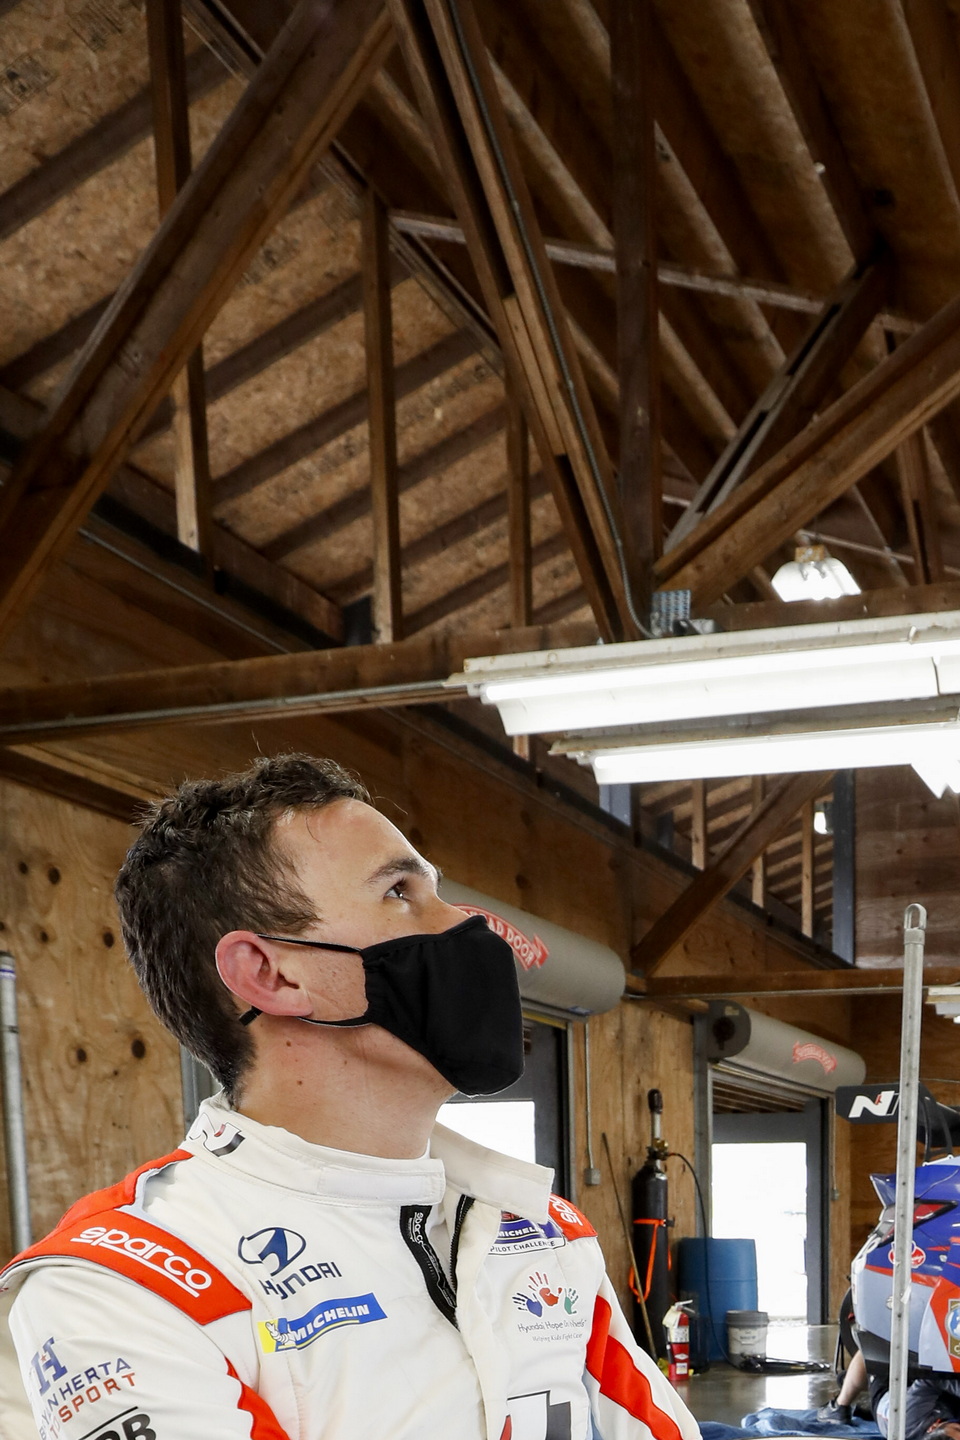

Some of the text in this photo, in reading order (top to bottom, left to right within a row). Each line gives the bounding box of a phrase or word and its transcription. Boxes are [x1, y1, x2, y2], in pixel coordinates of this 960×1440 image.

[507, 928, 535, 965] DOOR
[71, 1226, 212, 1297] sparco
[514, 1240, 555, 1250] CHALLENE
[258, 1262, 342, 1300] HNDAI
[290, 1304, 370, 1341] MICHELIN
[59, 1358, 131, 1400] HERTA
